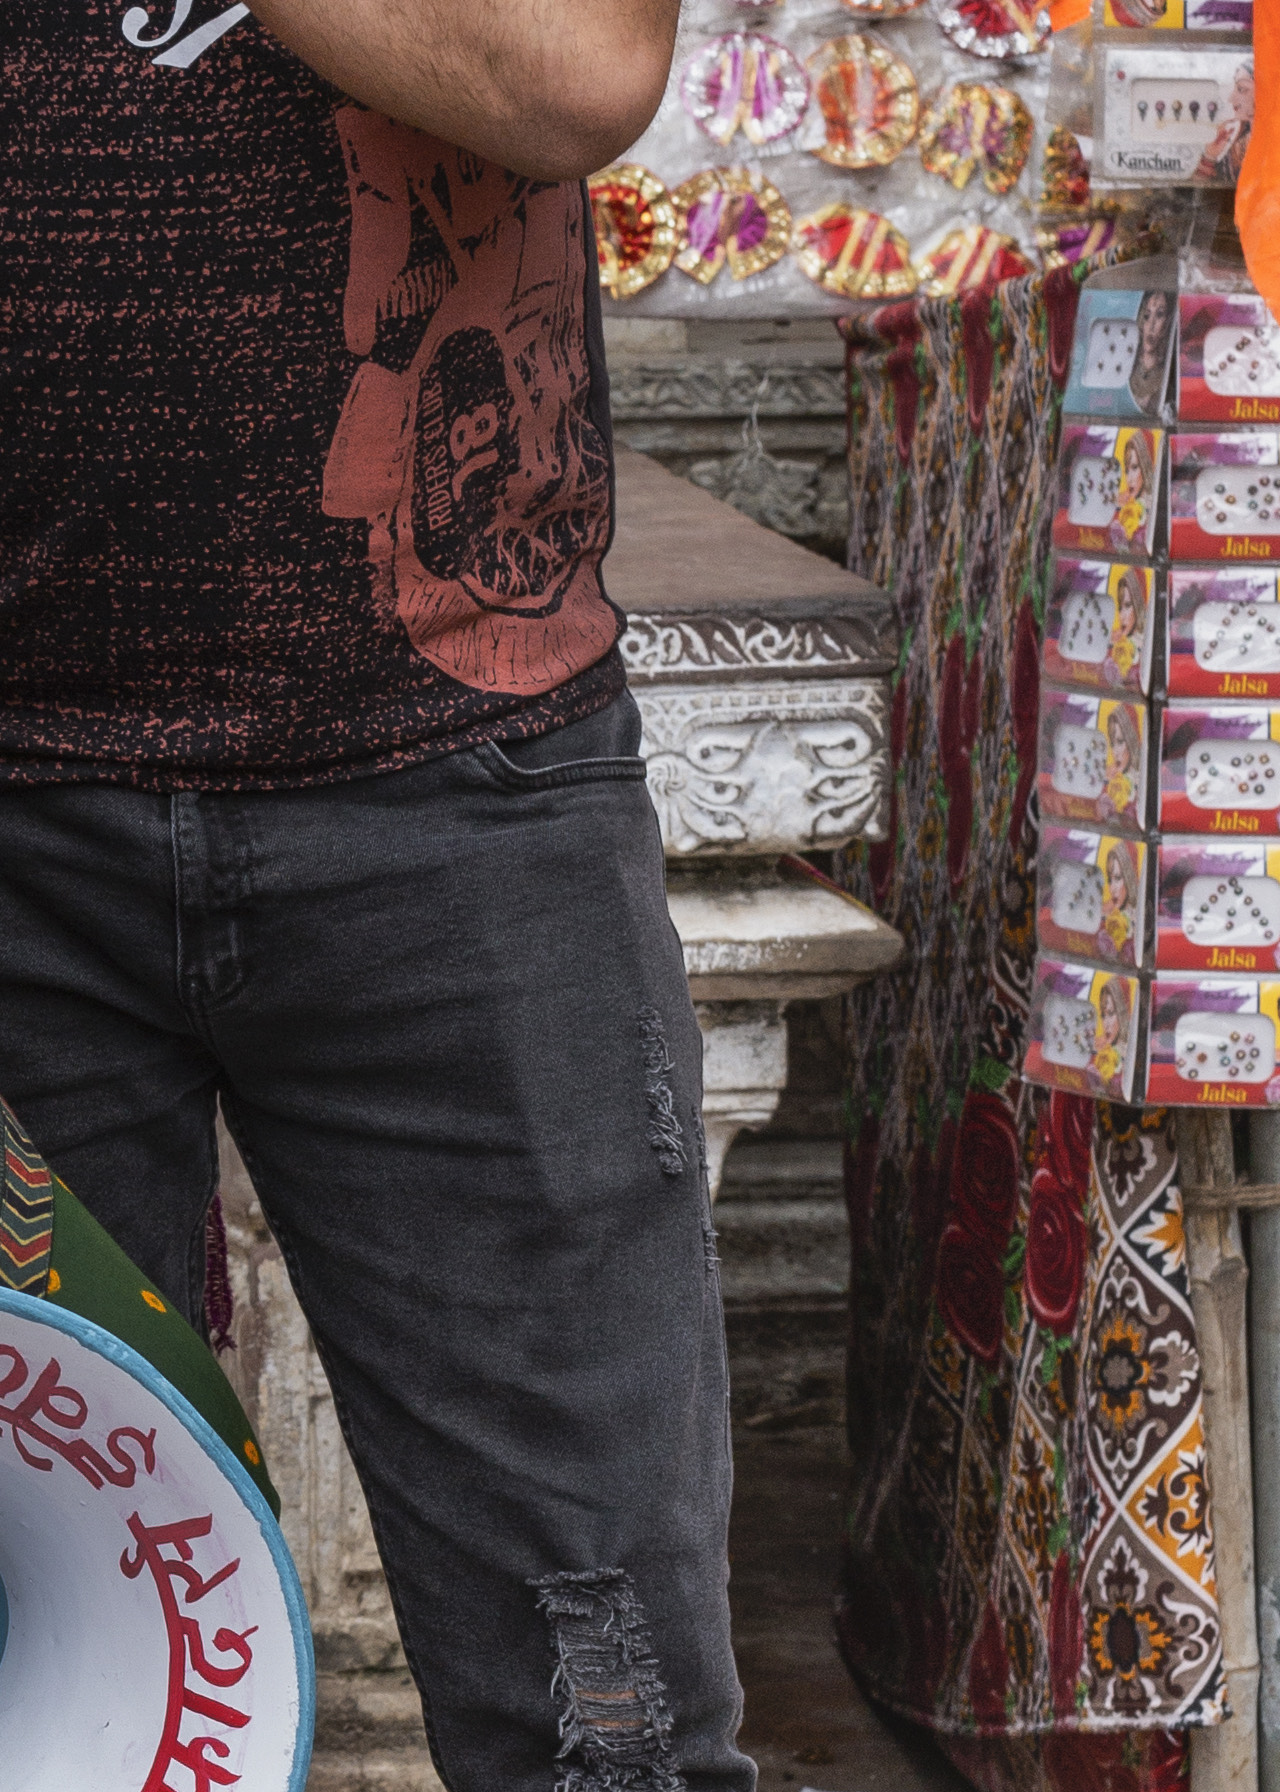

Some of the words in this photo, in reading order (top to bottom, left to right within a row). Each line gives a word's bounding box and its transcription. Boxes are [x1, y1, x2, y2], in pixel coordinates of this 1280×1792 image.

[1111, 150, 1183, 172] Kanchan
[1229, 397, 1279, 420] Jalsa
[449, 402, 500, 503] 18
[423, 444, 454, 532] RIDERS
[1220, 535, 1271, 557] Jalsa
[1218, 673, 1268, 695] Jalsa
[1209, 810, 1259, 832] Jalsa
[1206, 947, 1257, 969] Jalsa
[1197, 1082, 1247, 1104] Jalsa
